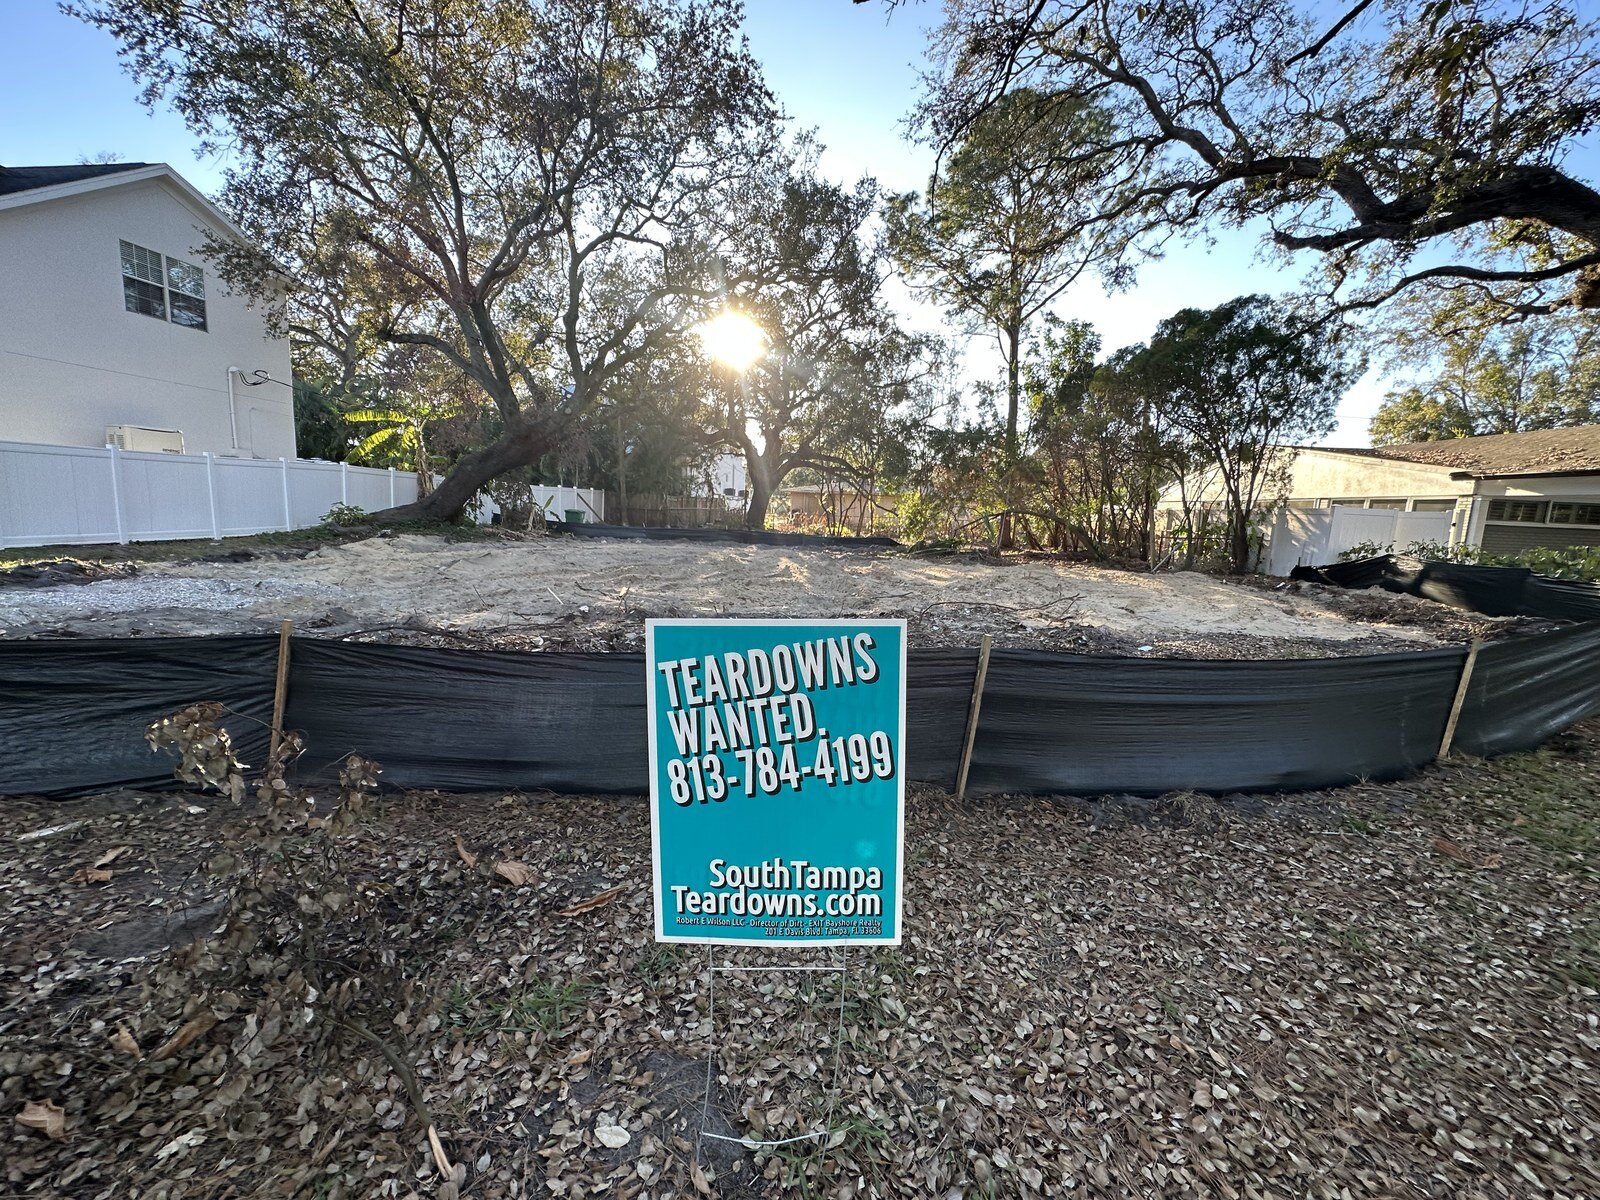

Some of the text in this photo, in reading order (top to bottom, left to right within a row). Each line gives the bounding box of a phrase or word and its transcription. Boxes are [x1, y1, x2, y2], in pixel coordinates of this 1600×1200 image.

[657, 632, 878, 708] TEARDOWNS
[666, 692, 828, 756] WANTED.
[666, 730, 894, 805] 813-784-4199
[709, 857, 882, 894] SouthTampa
[670, 884, 882, 917] Teardowns.com
[676, 916, 700, 925] Robert
[701, 917, 706, 925] E
[707, 917, 731, 926] Wilson
[732, 918, 744, 926] LLC
[750, 919, 779, 927] Director
[780, 919, 788, 927] of
[789, 919, 803, 927] Dirt
[808, 919, 824, 927] EXIT
[825, 919, 858, 928] Bayshore
[859, 918, 882, 928] Realty
[765, 927, 777, 936] 201
[779, 927, 784, 936] E
[785, 927, 804, 936] Davis
[825, 927, 850, 936] Tampa,
[851, 927, 859, 935] FL
[860, 927, 882, 935] 33606
